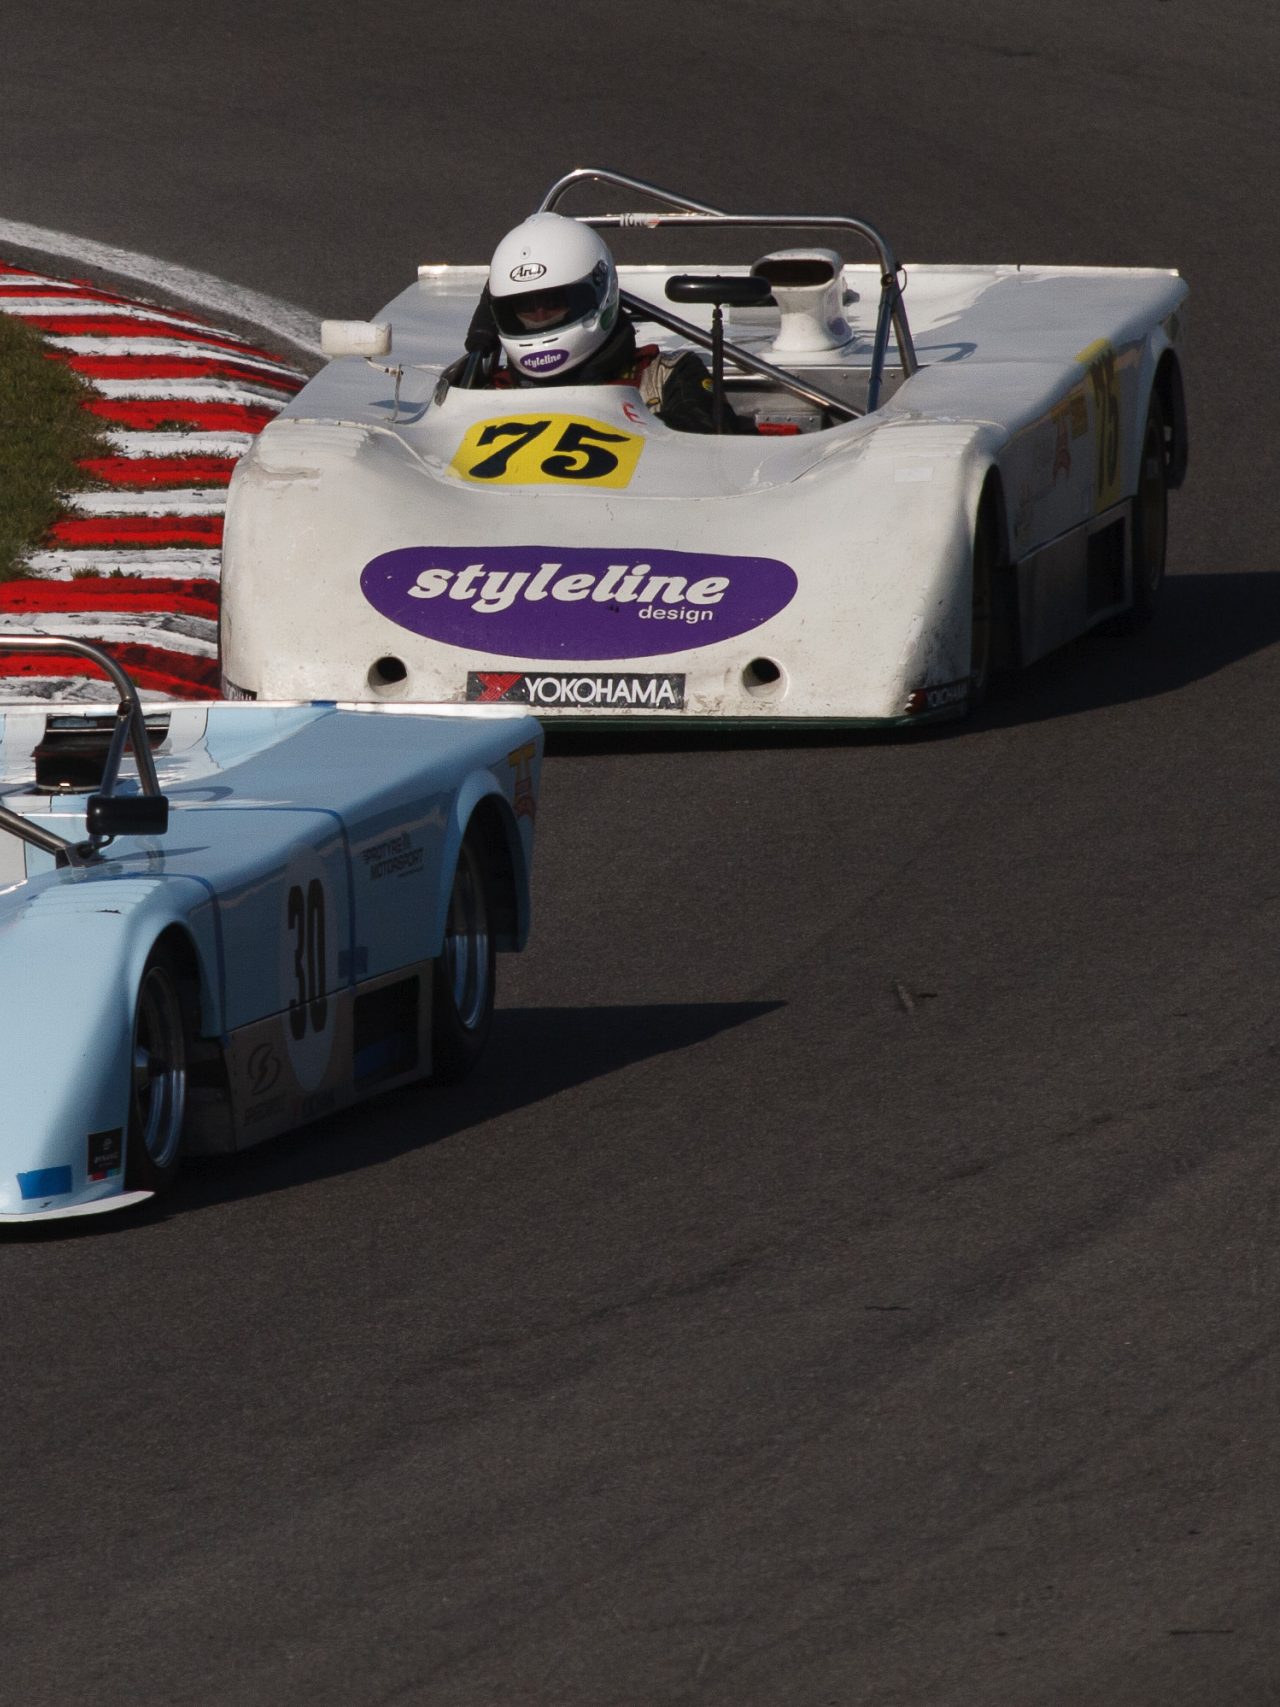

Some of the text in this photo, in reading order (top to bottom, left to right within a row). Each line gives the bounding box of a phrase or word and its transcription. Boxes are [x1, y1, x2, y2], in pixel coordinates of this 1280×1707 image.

[468, 420, 631, 480] 75
[407, 562, 731, 614] styleline
[638, 604, 714, 625] design
[524, 677, 676, 705] YOKOHAMA
[287, 878, 328, 1042] 30
